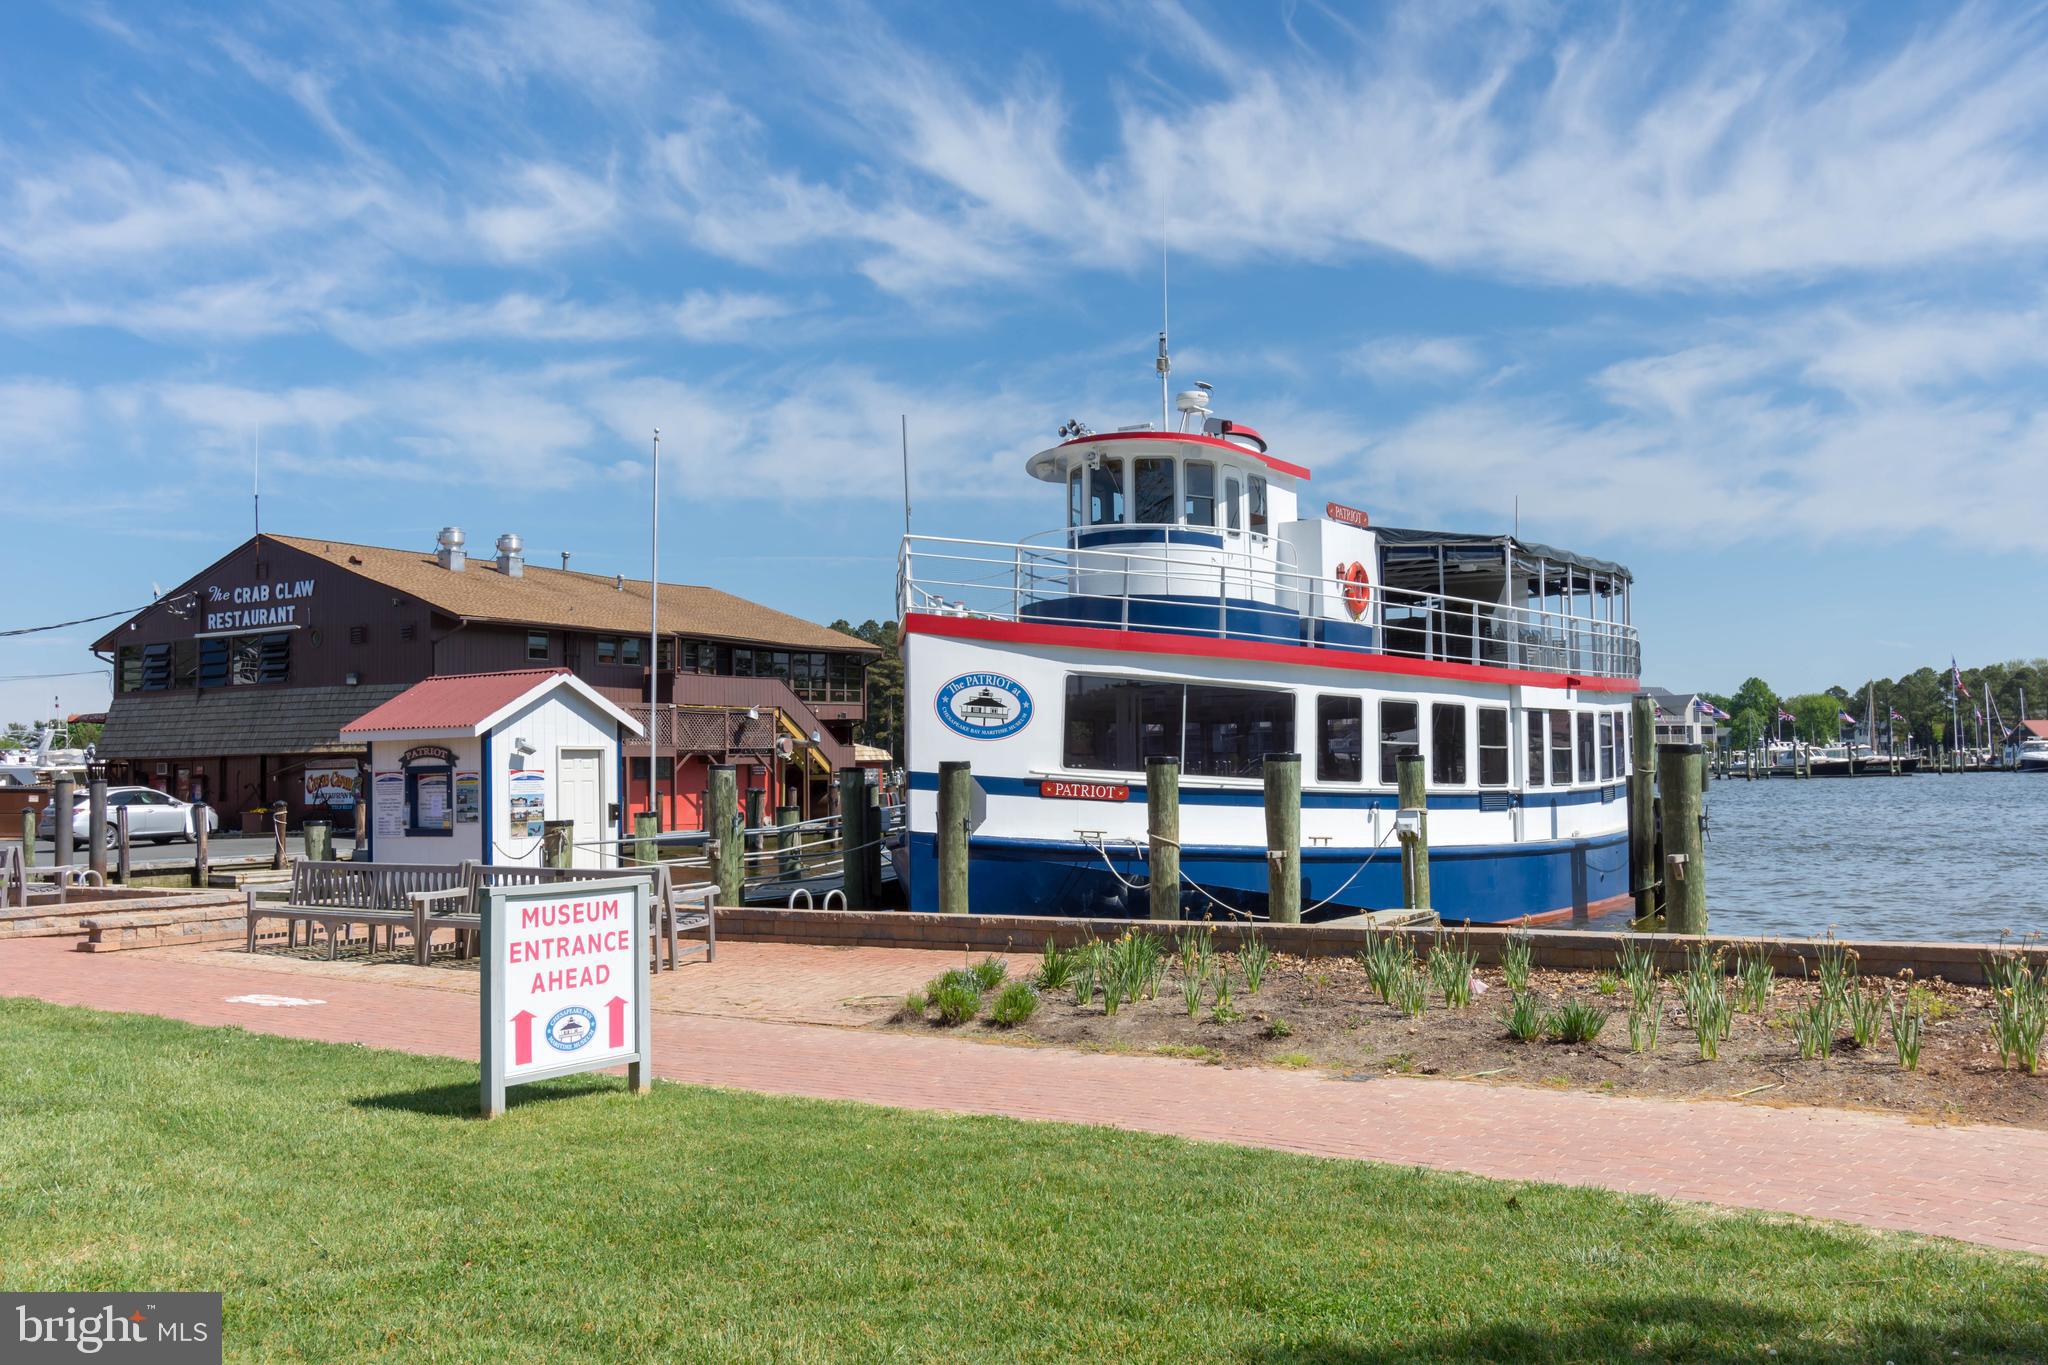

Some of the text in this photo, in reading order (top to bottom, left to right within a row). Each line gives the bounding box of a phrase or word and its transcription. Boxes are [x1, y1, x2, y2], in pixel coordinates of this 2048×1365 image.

[1335, 505, 1361, 523] PATRIOT
[208, 580, 315, 603] The CRAB CLAW
[207, 605, 296, 629] RESTAURANT
[946, 674, 1021, 697] The PATRIOT at
[405, 747, 448, 760] PATRIOT
[1055, 782, 1116, 799] PATRIOT
[521, 900, 619, 929] MUSEUM
[509, 930, 629, 964] ENTRANCE
[531, 964, 611, 994] AHEAD
